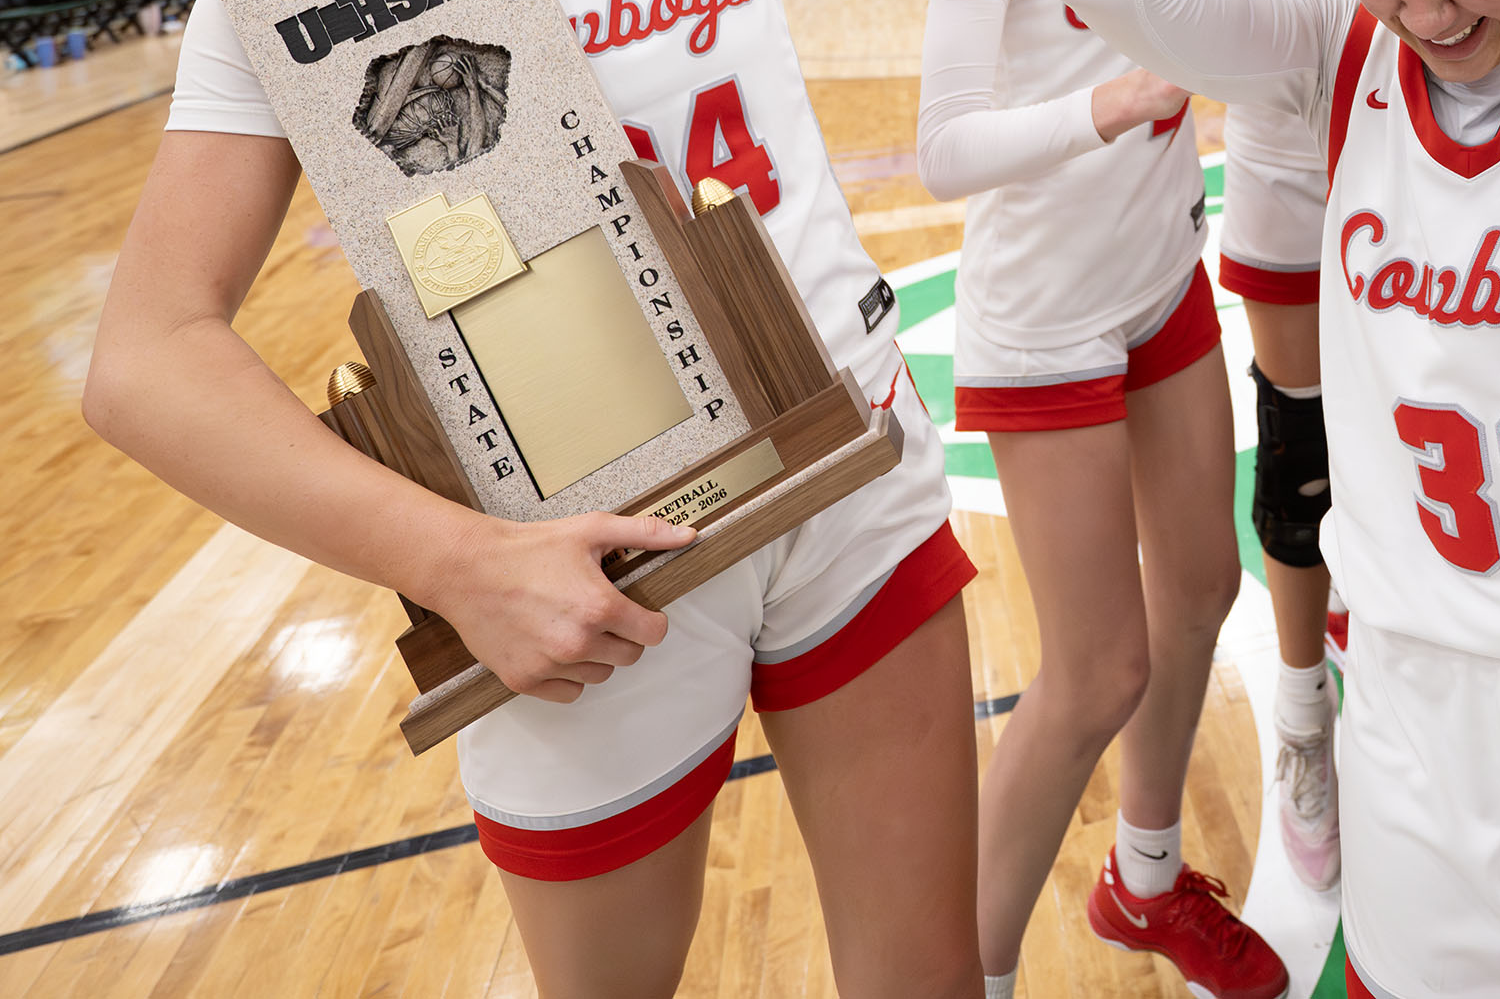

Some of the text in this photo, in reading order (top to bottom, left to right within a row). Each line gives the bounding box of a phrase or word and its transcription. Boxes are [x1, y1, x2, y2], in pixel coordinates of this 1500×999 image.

[618, 73, 783, 219] 4
[560, 109, 725, 422] CHAMPIONSHIP
[438, 347, 515, 481] STATE
[649, 479, 718, 520] KETBALL
[698, 488, 728, 511] 2026
